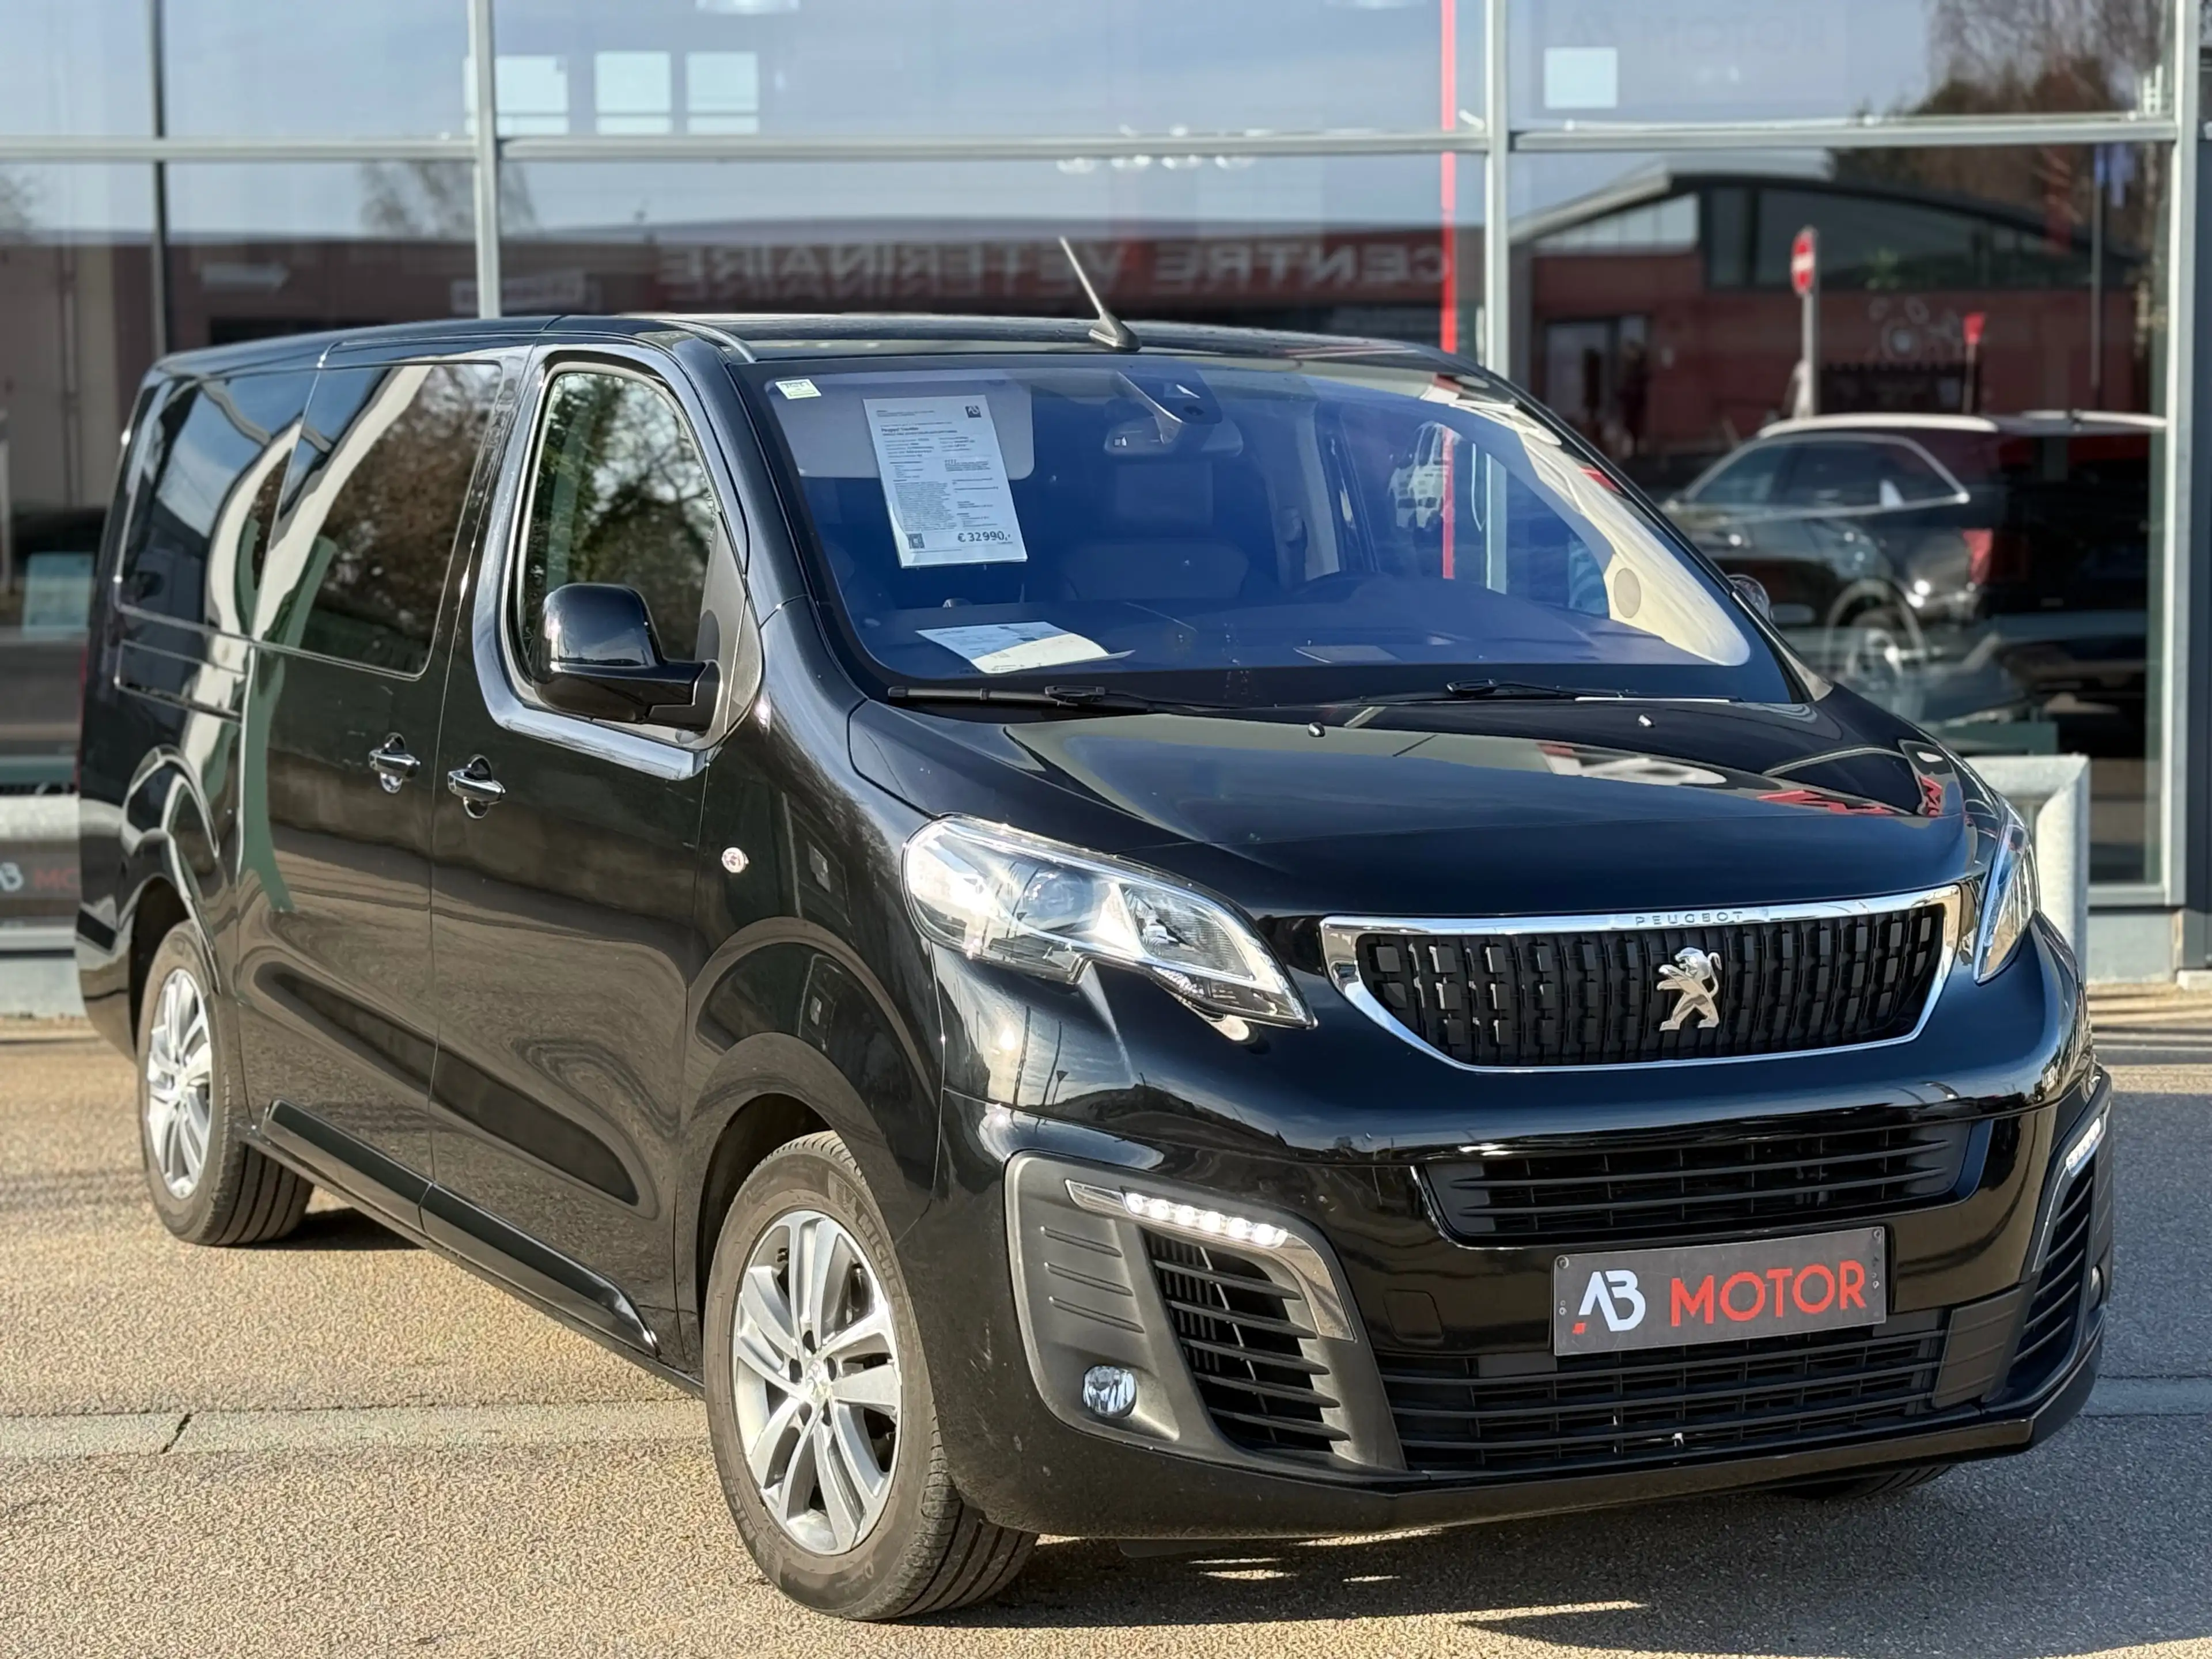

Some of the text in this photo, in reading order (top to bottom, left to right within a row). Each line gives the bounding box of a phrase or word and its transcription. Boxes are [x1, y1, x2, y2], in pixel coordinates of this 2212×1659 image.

[1635, 911, 1743, 926] PEUGEOT
[857, 1212, 911, 1347] MICHEL
[1578, 1259, 1868, 1332] AB MOTOR
